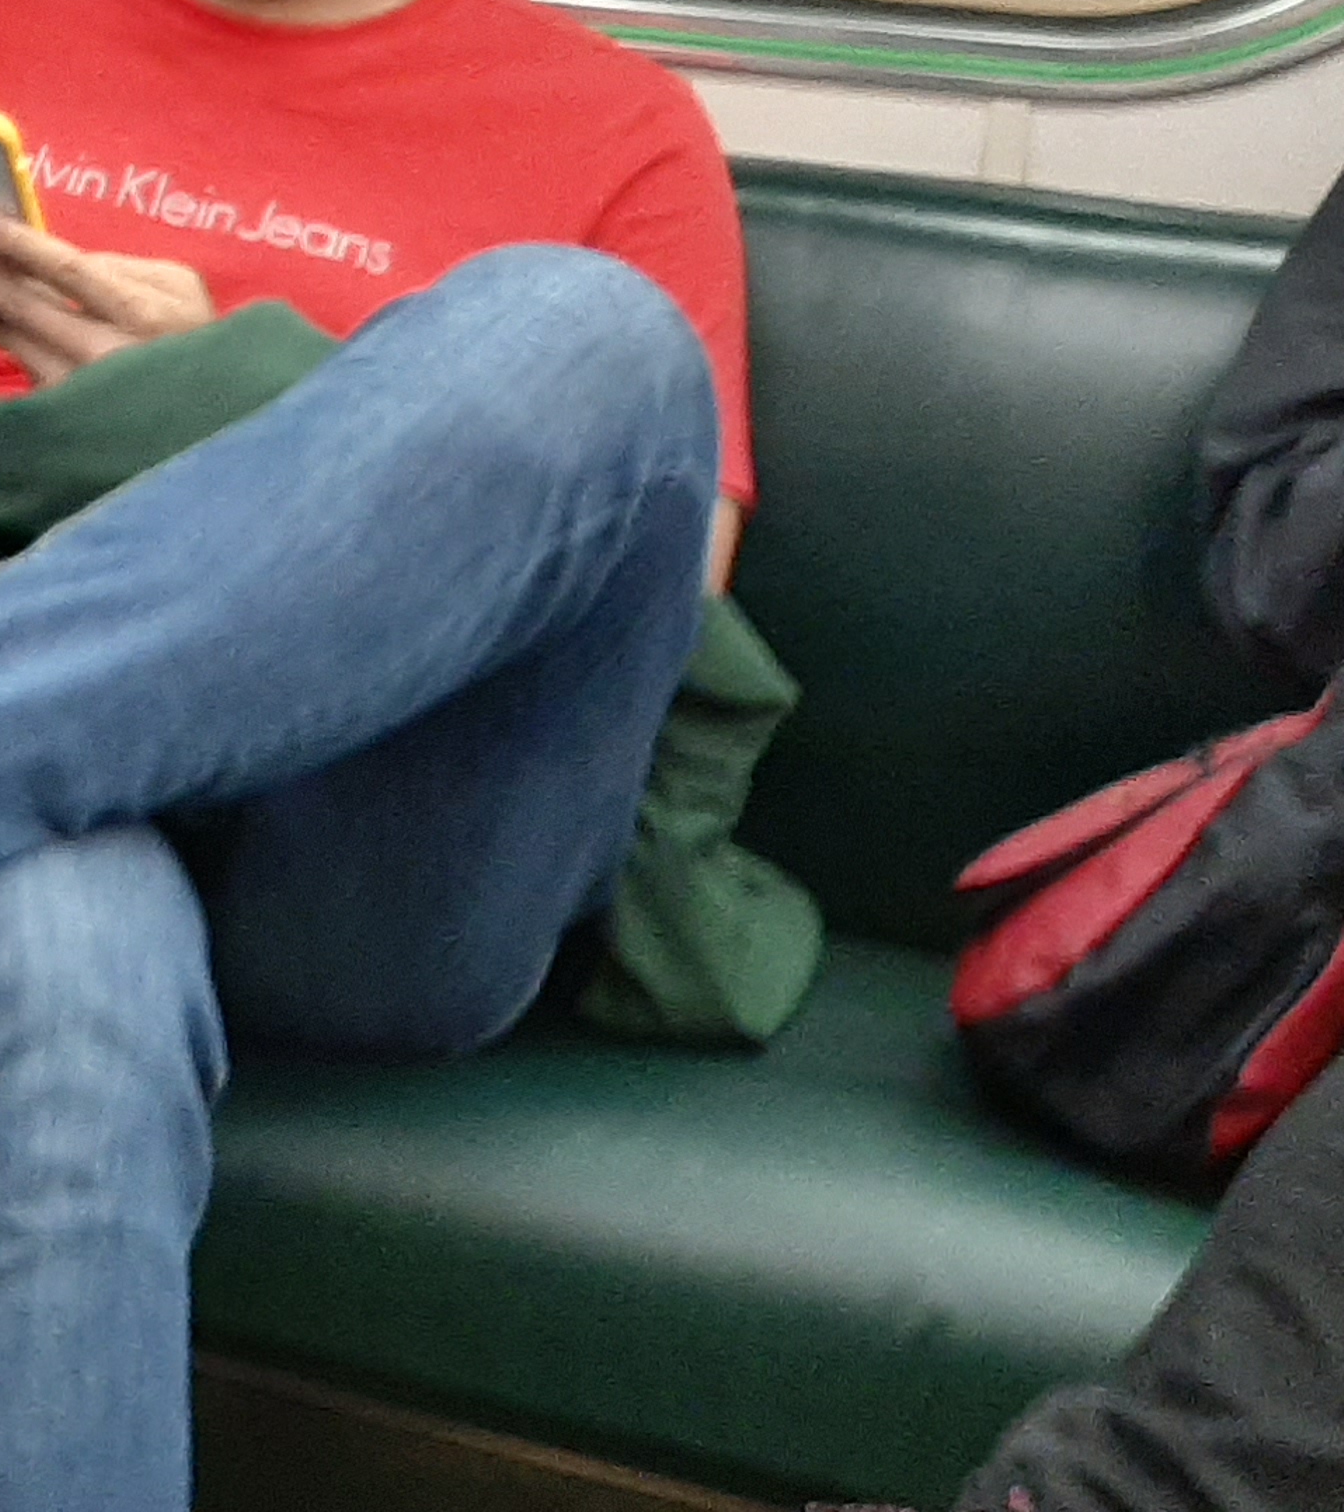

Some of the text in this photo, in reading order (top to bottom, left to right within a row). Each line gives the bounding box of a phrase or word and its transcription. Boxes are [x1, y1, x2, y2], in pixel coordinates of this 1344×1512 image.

[26, 143, 393, 276] lvin Klein Jeans
